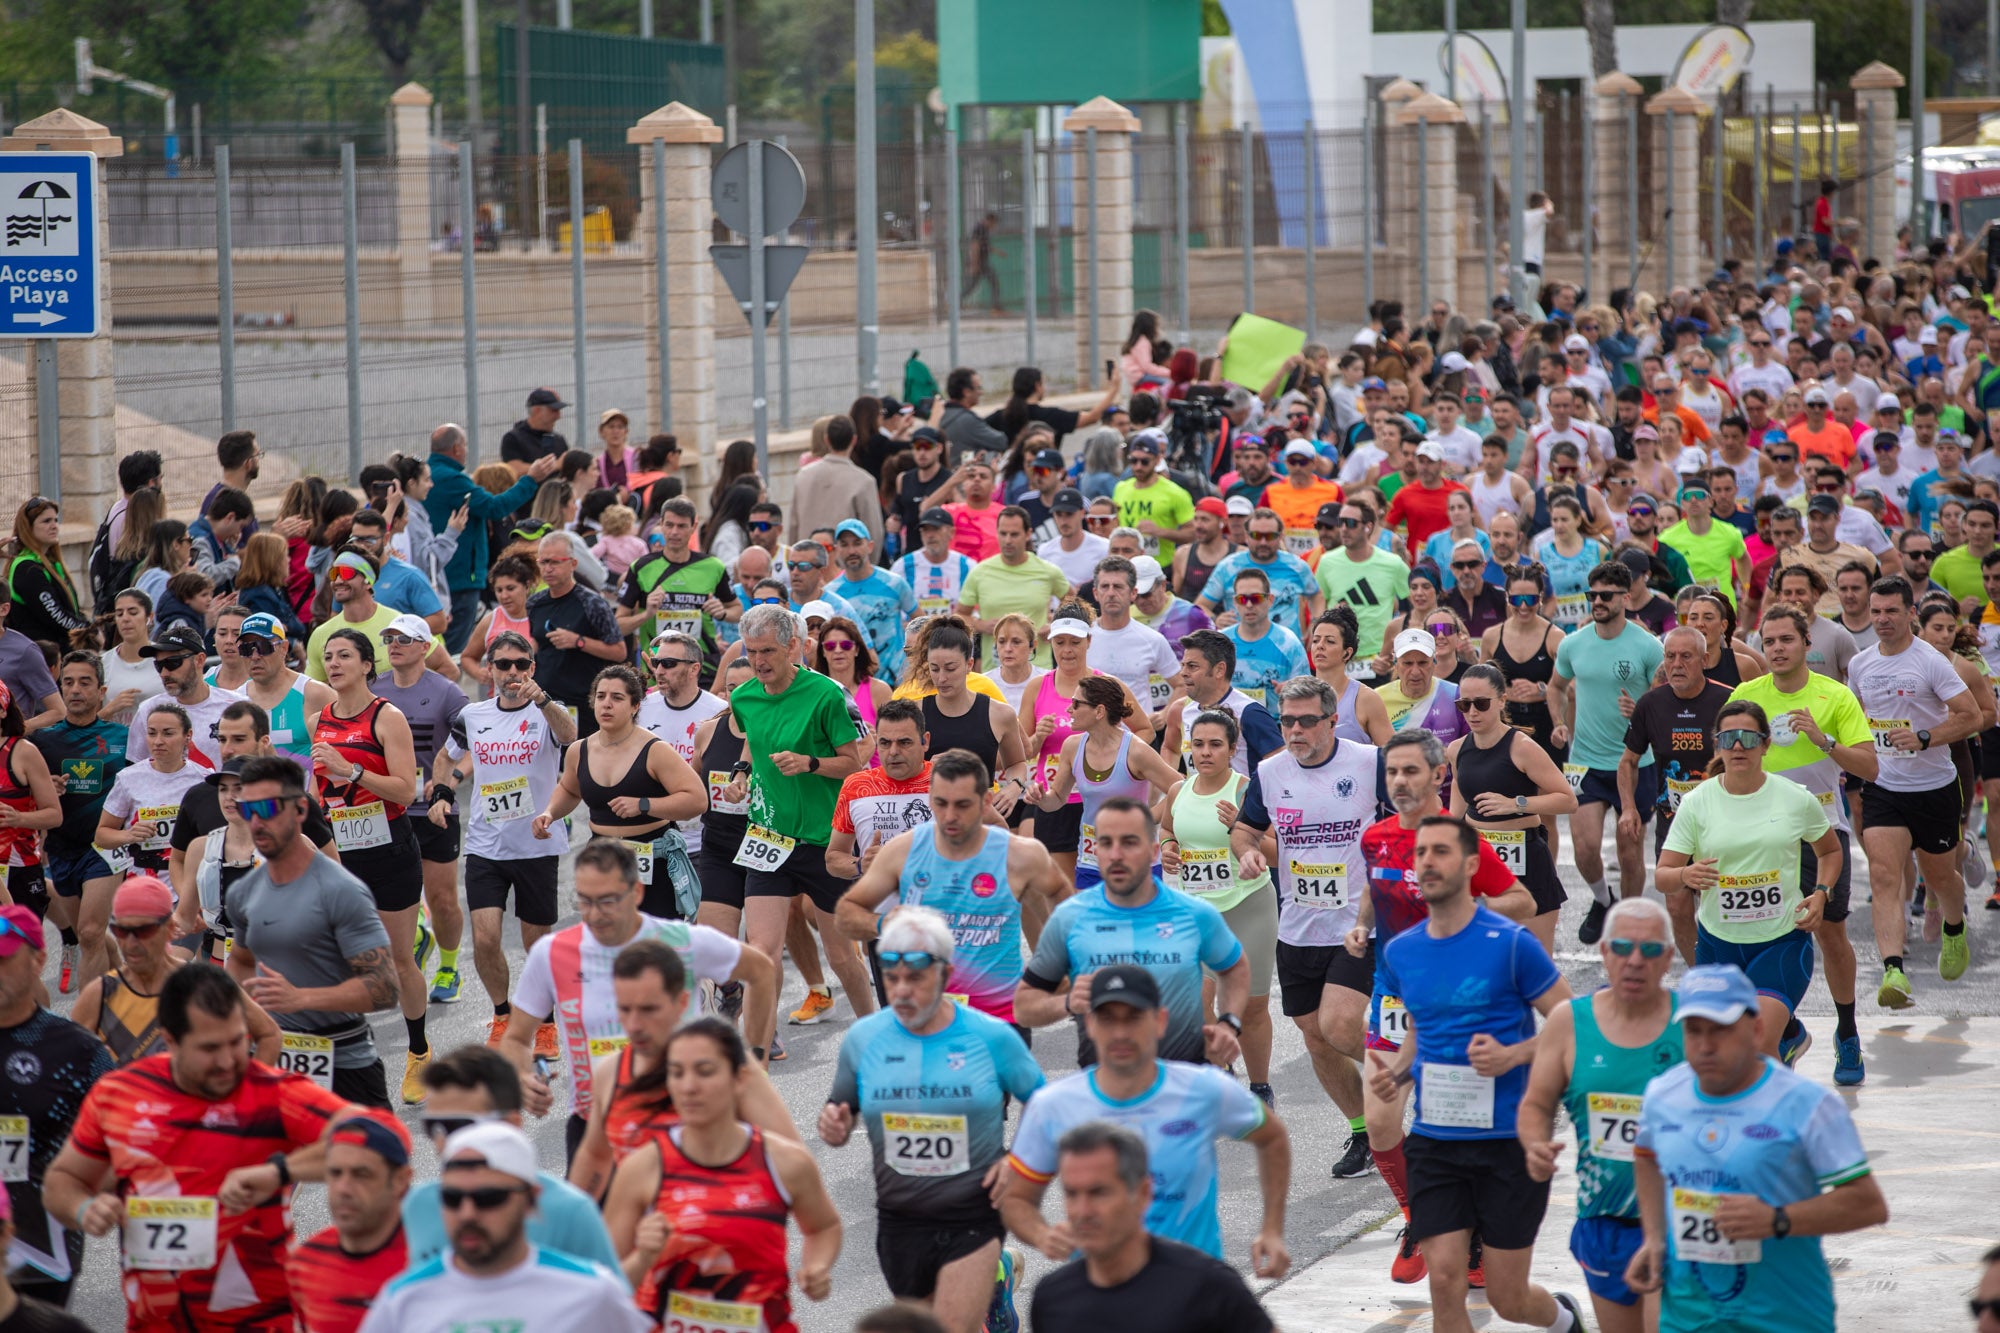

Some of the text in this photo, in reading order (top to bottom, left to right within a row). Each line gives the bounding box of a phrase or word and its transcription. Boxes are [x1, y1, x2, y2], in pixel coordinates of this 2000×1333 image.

[1, 265, 78, 282] Acceso
[10, 286, 69, 307] Playa
[474, 739, 540, 754] Domingo
[1672, 733, 1703, 741] FONDO
[1672, 740, 1704, 751] 2025
[478, 752, 533, 765] Runner
[488, 791, 522, 813] 317
[874, 802, 896, 814] XII
[340, 818, 373, 839] 4100
[1278, 818, 1361, 837] CARRERA
[1281, 831, 1360, 846] UNIVERSIDAD
[745, 839, 781, 864] 596
[1182, 863, 1230, 882] 3216
[1297, 878, 1338, 897] 814
[1721, 886, 1782, 910] 3296
[1089, 950, 1182, 967] ALMUÑÉCAR
[871, 1083, 973, 1101] ALMUÑÉCAR
[896, 1136, 954, 1159] 220
[145, 1223, 187, 1250] 72
